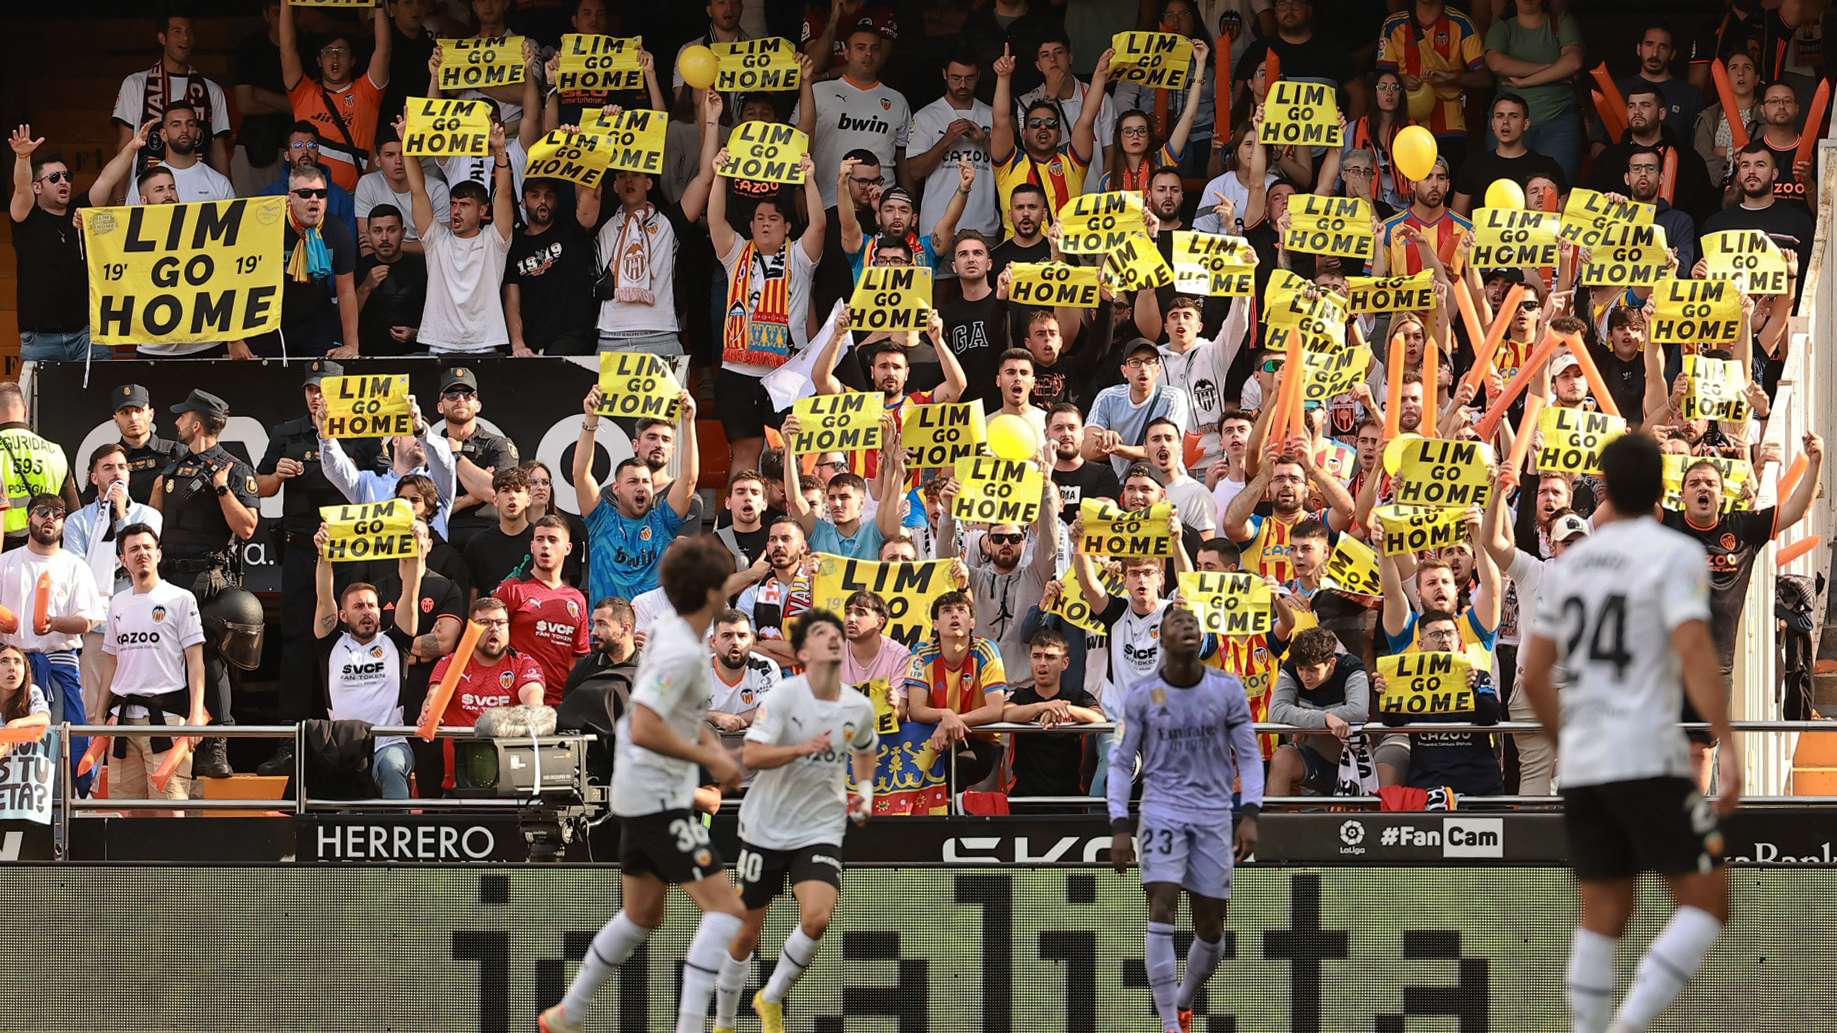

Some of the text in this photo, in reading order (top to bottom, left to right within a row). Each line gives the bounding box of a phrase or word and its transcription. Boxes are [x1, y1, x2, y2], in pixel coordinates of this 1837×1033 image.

[573, 35, 625, 55] LIM
[729, 38, 780, 55] LIM
[1126, 32, 1177, 55] LIM
[467, 50, 496, 64] GO
[584, 55, 613, 69] GO
[743, 55, 771, 68] GO
[1137, 54, 1162, 68] GO
[444, 64, 523, 86] HOME
[560, 70, 640, 89] HOME
[718, 69, 798, 89] HOME
[1109, 67, 1184, 89] HOME
[1275, 83, 1324, 106] LIM
[420, 100, 474, 117] LIM
[1287, 107, 1314, 122] GO
[432, 117, 460, 131] GO
[596, 111, 650, 132] LIM
[838, 113, 888, 134] bwin
[406, 133, 486, 154] HOME
[546, 131, 599, 152] LIM
[739, 125, 794, 145] LIM
[1261, 123, 1340, 144] HOME
[555, 147, 581, 159] GO
[750, 144, 778, 158] GO
[526, 159, 601, 184] HOME
[720, 158, 801, 181] HOME
[1074, 193, 1126, 215] LIM
[1304, 197, 1359, 217] LIM
[1584, 193, 1640, 222] LIM
[123, 200, 247, 252] LIM
[1087, 216, 1116, 230] GO
[1316, 218, 1345, 231] GO
[1487, 210, 1543, 228] LIM
[1188, 234, 1238, 256] LIM
[1289, 232, 1371, 256] HOME
[1499, 229, 1528, 242] GO
[1601, 225, 1655, 247] LIM
[1720, 233, 1768, 253] LIM
[1199, 256, 1225, 271] GO
[1473, 244, 1557, 265] HOME
[1612, 248, 1643, 262] GO
[1732, 256, 1758, 269] GO
[103, 254, 262, 288] 19' GO 19'
[862, 269, 912, 291] LIM
[1040, 267, 1070, 281] GO
[874, 292, 902, 307] GO
[1012, 282, 1097, 304] HOME
[1351, 289, 1431, 310] HOME
[1669, 282, 1724, 302] LIM
[99, 285, 277, 336] HOME
[849, 308, 928, 328] HOME
[1682, 304, 1710, 318] GO
[1299, 317, 1326, 334] GO
[1654, 320, 1738, 340] HOME
[617, 355, 668, 377] LIM
[1306, 348, 1355, 371] LIM
[627, 378, 655, 393] GO
[1315, 371, 1342, 383] GO
[339, 377, 392, 399] LIM
[352, 400, 381, 414] GO
[601, 394, 680, 418] HOME
[810, 394, 864, 414] LIM
[1686, 397, 1745, 421] HOME
[328, 414, 408, 435] HOME
[822, 414, 851, 428] GO
[919, 405, 970, 427] LIM
[798, 427, 878, 451] HOME
[932, 428, 960, 443] GO
[1568, 434, 1597, 447] GO
[1419, 441, 1476, 465] LIM
[1541, 447, 1604, 470] HOM
[971, 458, 1026, 482] LIM
[1431, 466, 1461, 480] GO
[983, 483, 1012, 497] GO
[1401, 481, 1488, 508] HOME
[340, 503, 394, 521] LIM
[955, 498, 1037, 523] HOME
[1409, 514, 1438, 527] GO
[353, 520, 383, 534] GO
[1110, 521, 1141, 534] GO
[1387, 520, 1467, 552] HOME
[327, 535, 413, 558] HOME
[1085, 535, 1169, 555] HOME
[842, 559, 936, 593] LIM
[1198, 573, 1252, 595] LIM
[1210, 595, 1239, 610] GO
[1207, 612, 1268, 632] OME
[1562, 592, 1632, 683] 24
[1397, 654, 1452, 677] LIM
[1411, 678, 1441, 692] GO
[1384, 692, 1471, 713] HOME
[1158, 726, 1216, 740] Emirates
[19, 757, 49, 783] TU
[317, 825, 495, 858] HERRERO
[1142, 829, 1173, 855] 23
[1340, 846, 1365, 855] LaLiga
